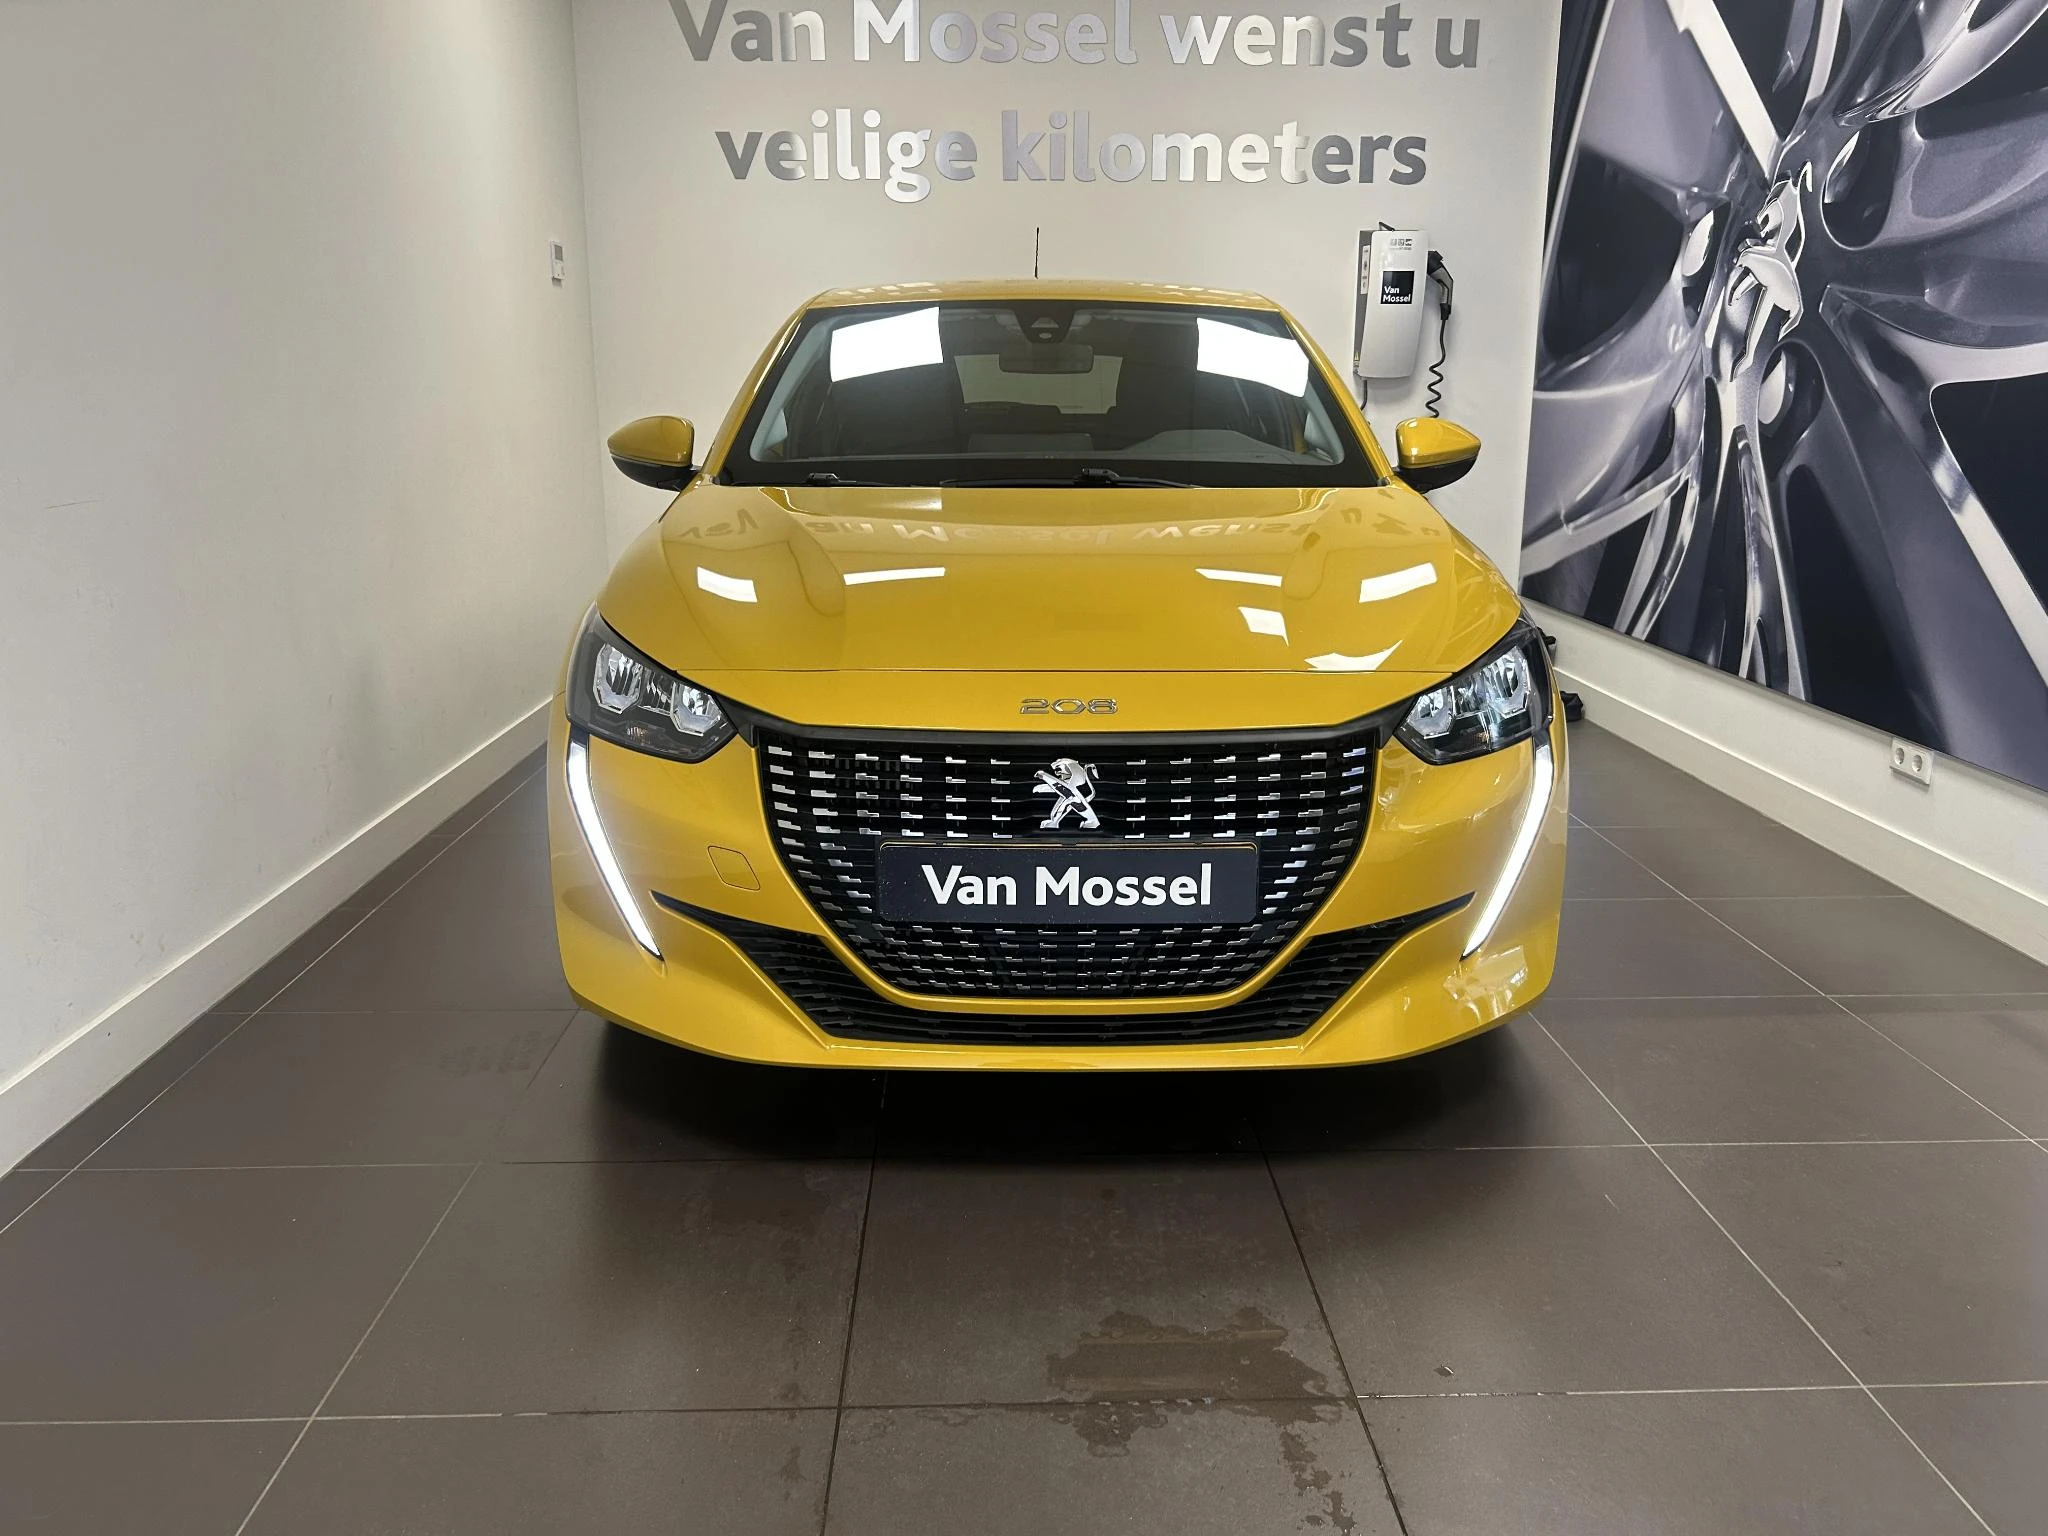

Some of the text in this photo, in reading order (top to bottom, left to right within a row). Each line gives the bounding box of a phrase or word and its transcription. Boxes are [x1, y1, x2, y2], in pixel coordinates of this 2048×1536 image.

[671, 0, 1480, 68] Van Mossel wenst u
[715, 108, 1427, 203] veilige kilometers
[1382, 294, 1412, 303] Mossel
[1384, 286, 1400, 294] Van
[1019, 698, 1119, 715] 208
[921, 862, 1212, 906] Van Mossel
